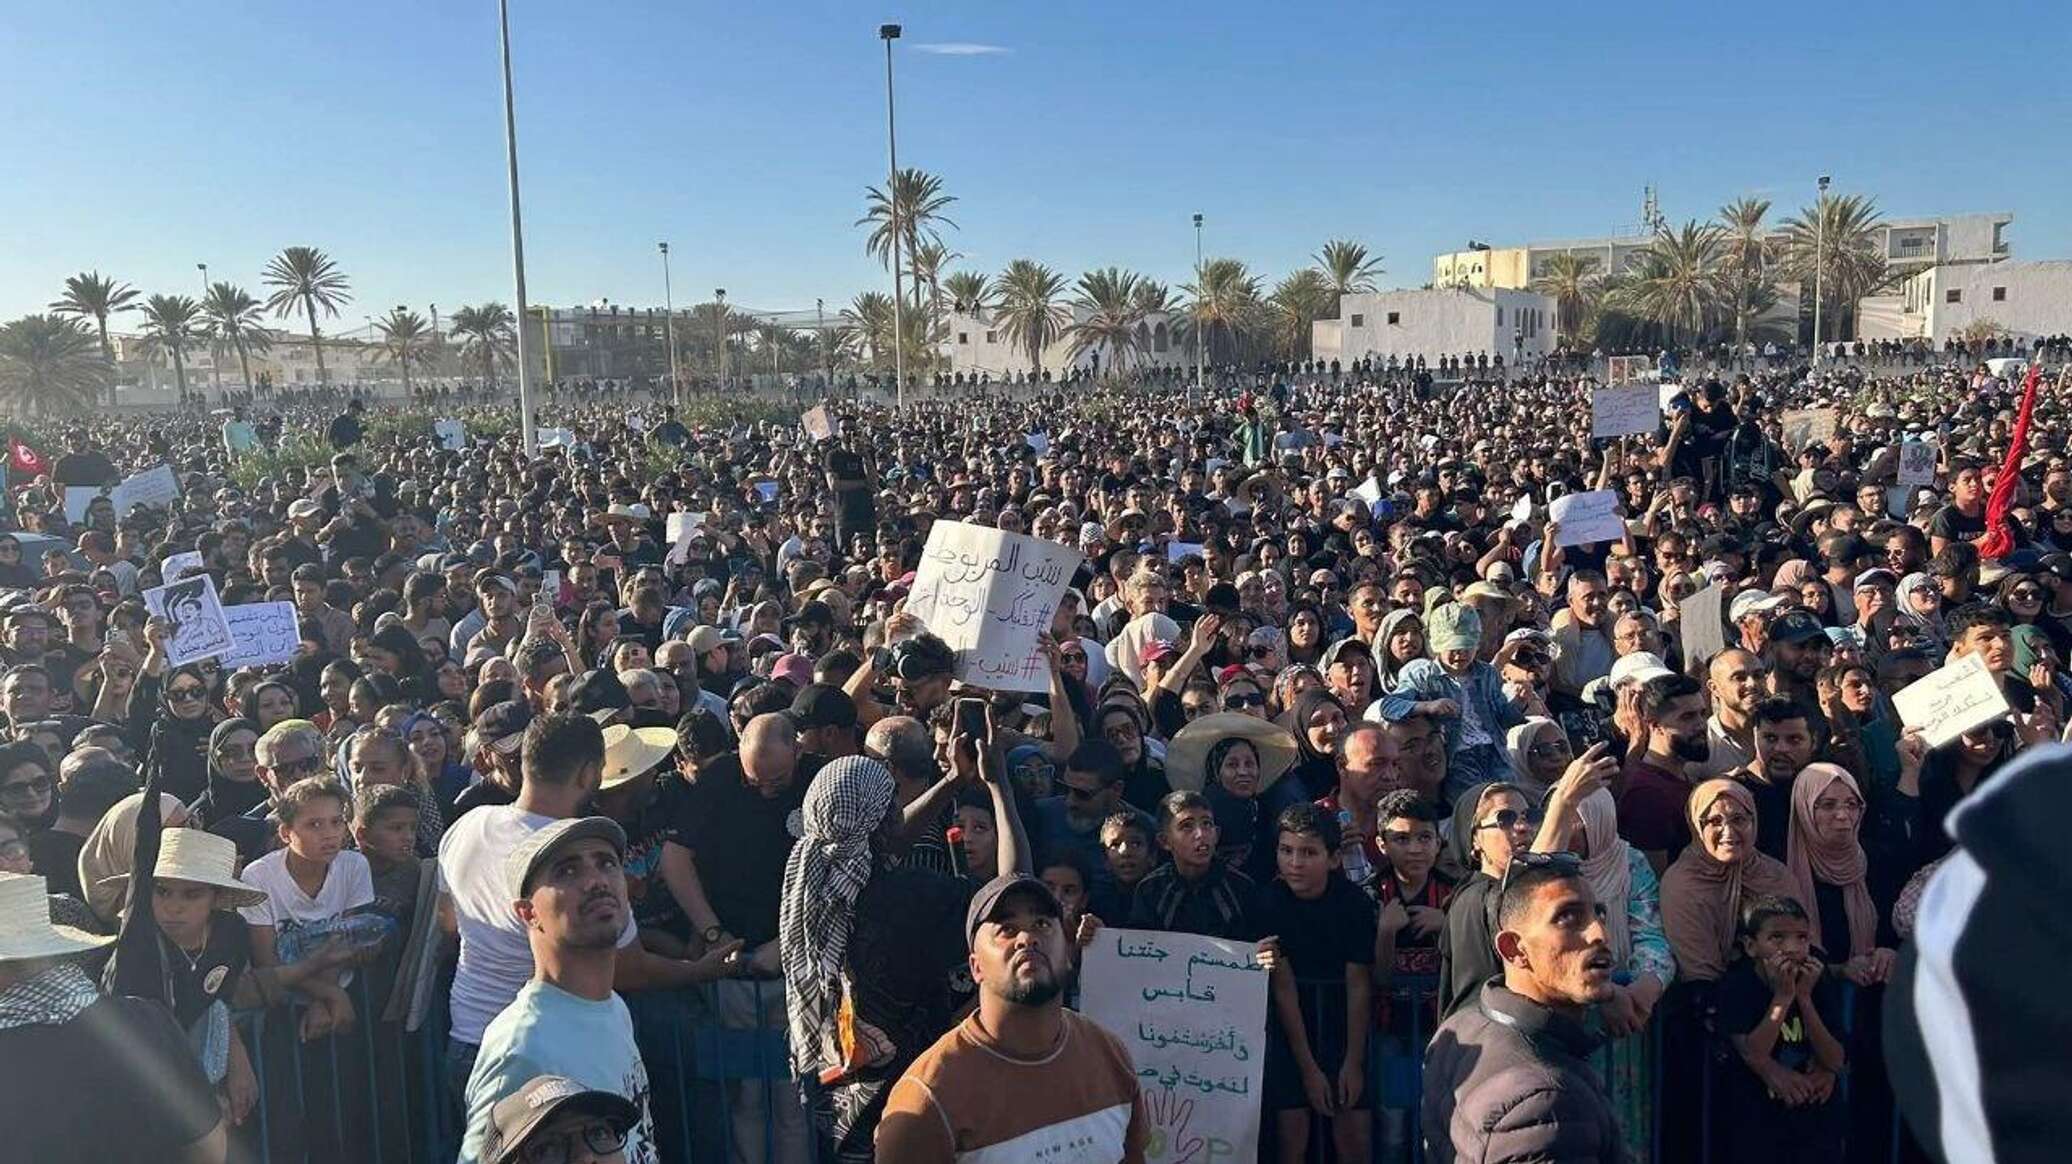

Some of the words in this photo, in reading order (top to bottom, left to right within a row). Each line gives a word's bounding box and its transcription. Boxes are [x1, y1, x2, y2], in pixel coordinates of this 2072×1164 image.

[1142, 974, 1216, 1003] قابس
[1036, 1144, 1061, 1158] NEW
[1069, 1136, 1094, 1149] AGE
